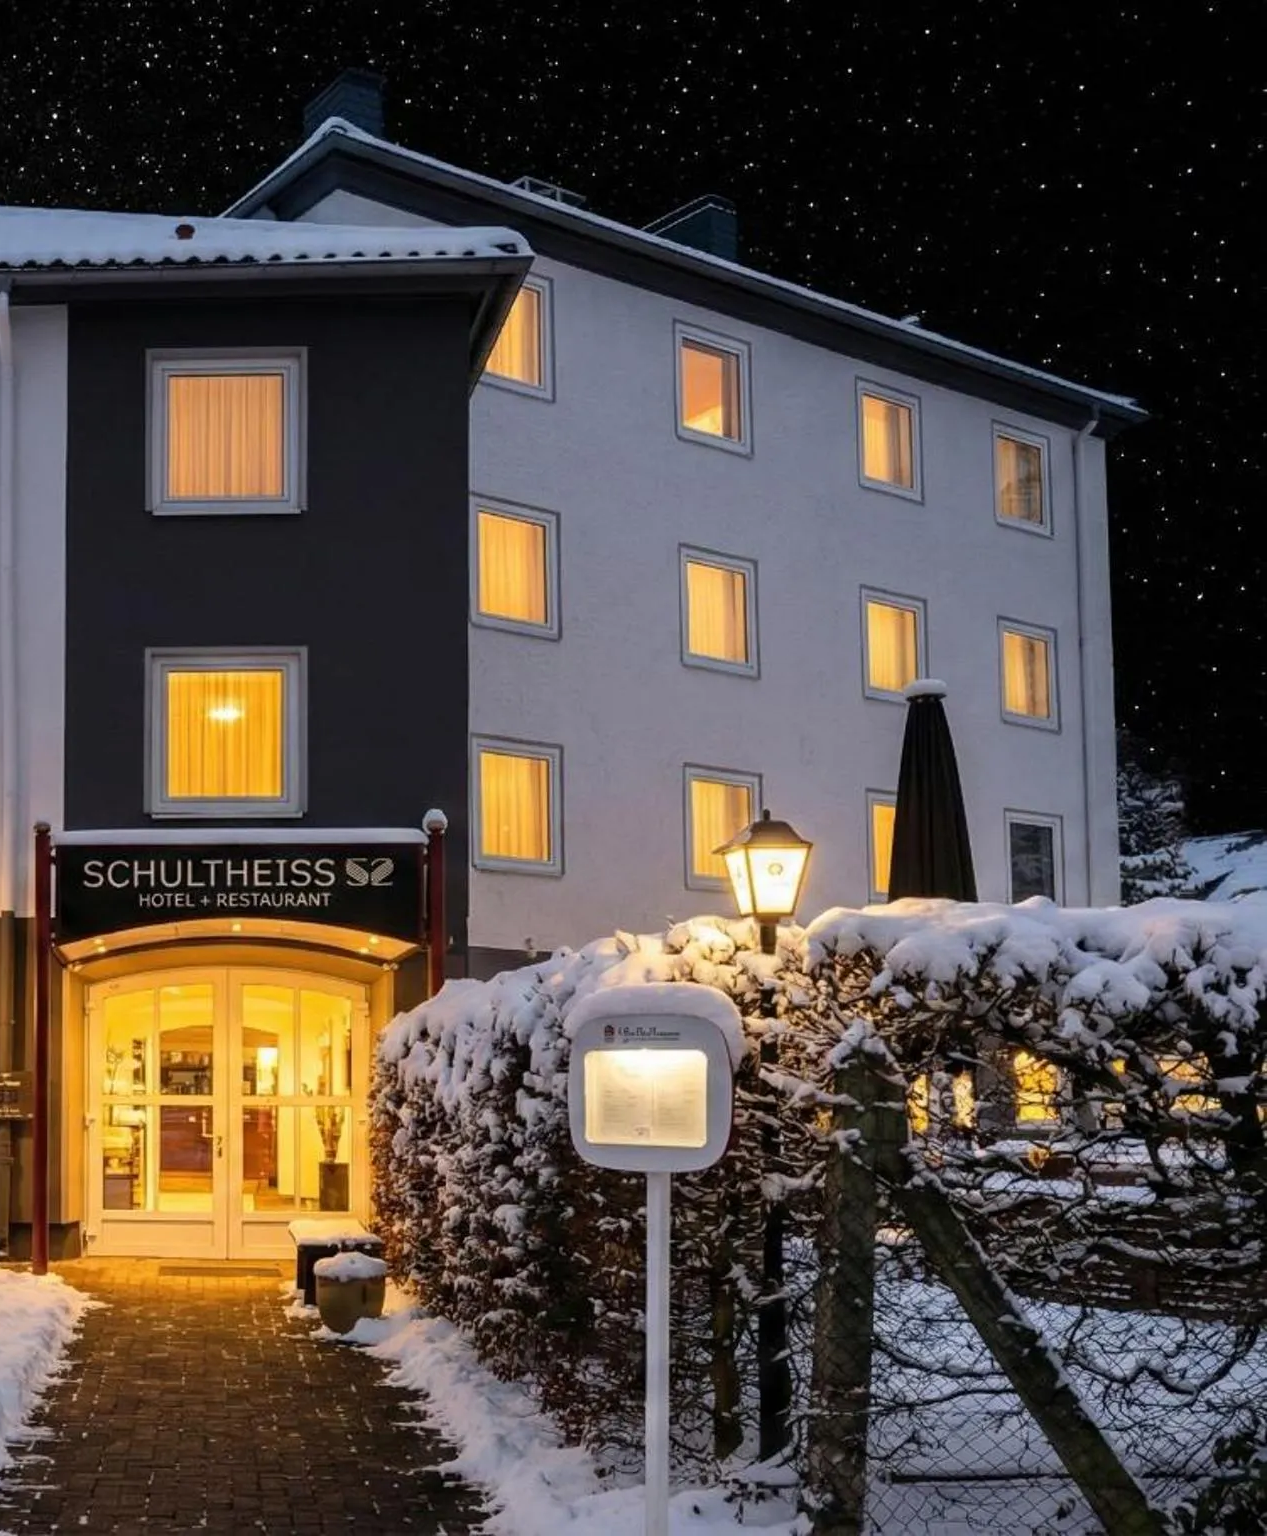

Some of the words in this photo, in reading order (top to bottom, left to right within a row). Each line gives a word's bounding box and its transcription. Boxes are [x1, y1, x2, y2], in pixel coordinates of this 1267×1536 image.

[83, 859, 336, 888] SCHULTHEISS
[139, 893, 195, 908] HOTEL
[216, 892, 331, 908] RESTAURANT
